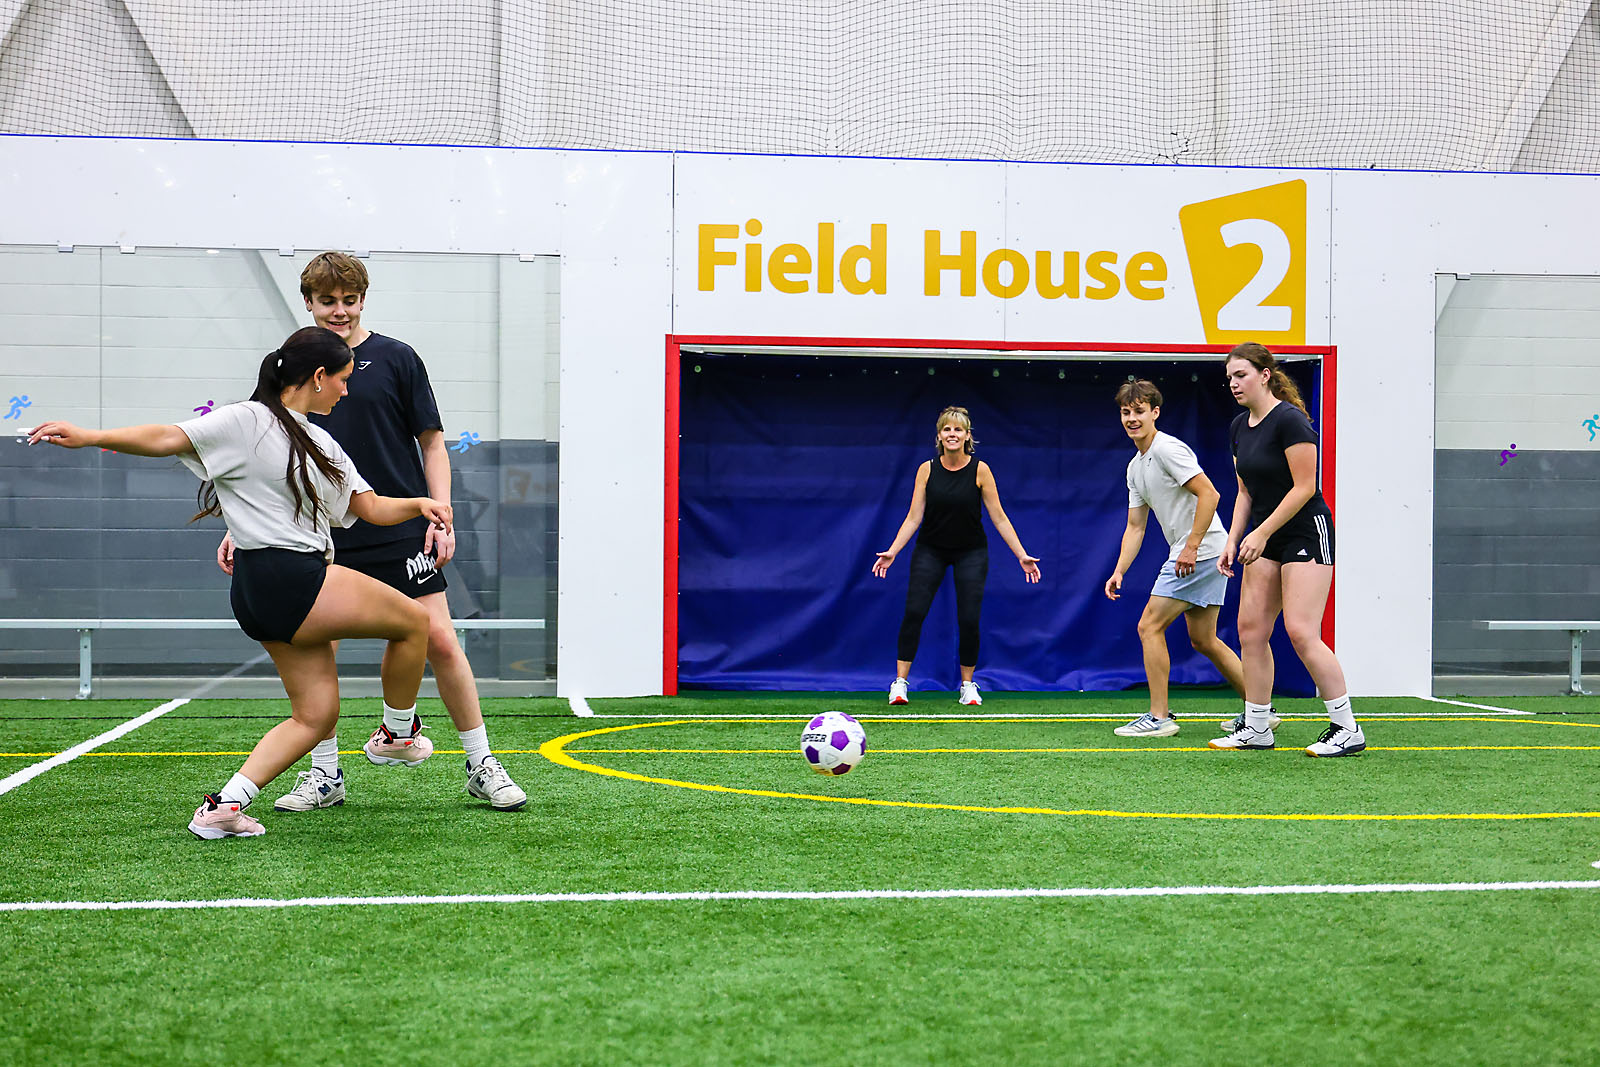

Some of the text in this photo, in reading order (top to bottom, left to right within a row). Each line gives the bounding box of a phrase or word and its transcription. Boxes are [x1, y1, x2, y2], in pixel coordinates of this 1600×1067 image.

[698, 218, 1292, 332] Field House 2
